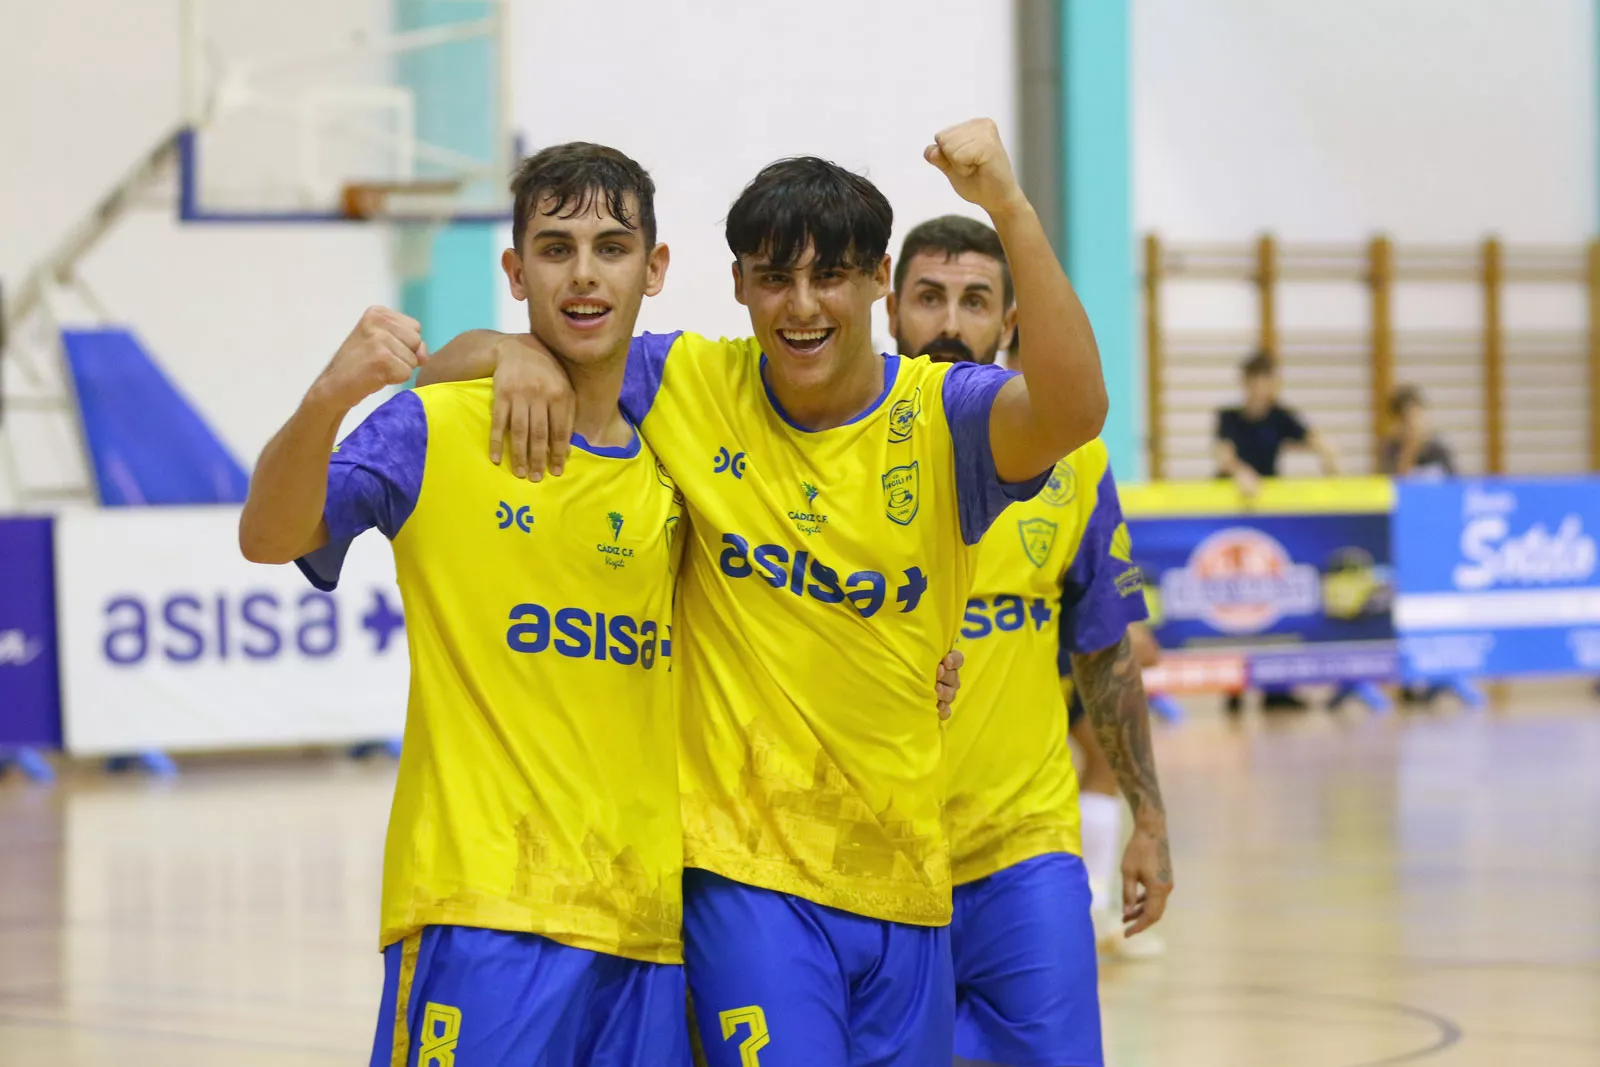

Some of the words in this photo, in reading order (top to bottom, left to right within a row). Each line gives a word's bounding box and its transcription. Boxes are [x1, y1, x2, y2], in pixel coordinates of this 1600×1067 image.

[719, 532, 887, 619] asisa
[102, 592, 339, 666] asisa
[506, 603, 657, 671] asisa
[418, 1001, 462, 1067] 8
